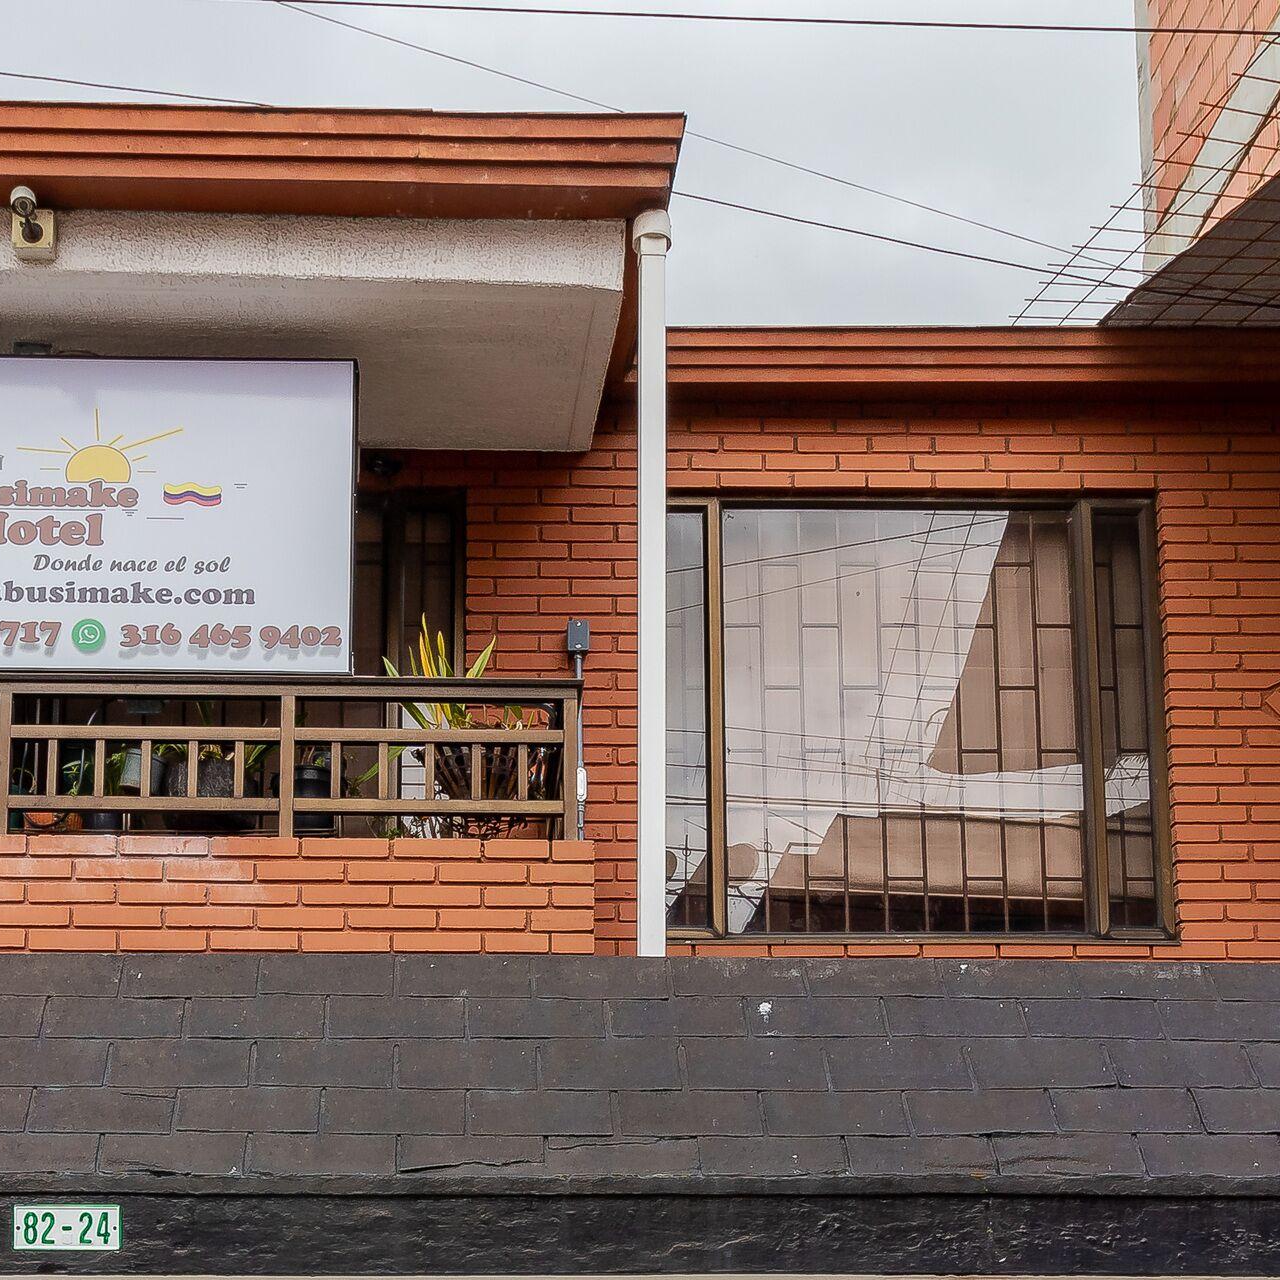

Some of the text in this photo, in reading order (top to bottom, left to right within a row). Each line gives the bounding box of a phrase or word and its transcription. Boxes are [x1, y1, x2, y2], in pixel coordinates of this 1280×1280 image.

[33, 554, 231, 574] Donde nace el sol
[119, 622, 342, 649] 316 465 9402
[23, 1211, 111, 1245] 82-24
